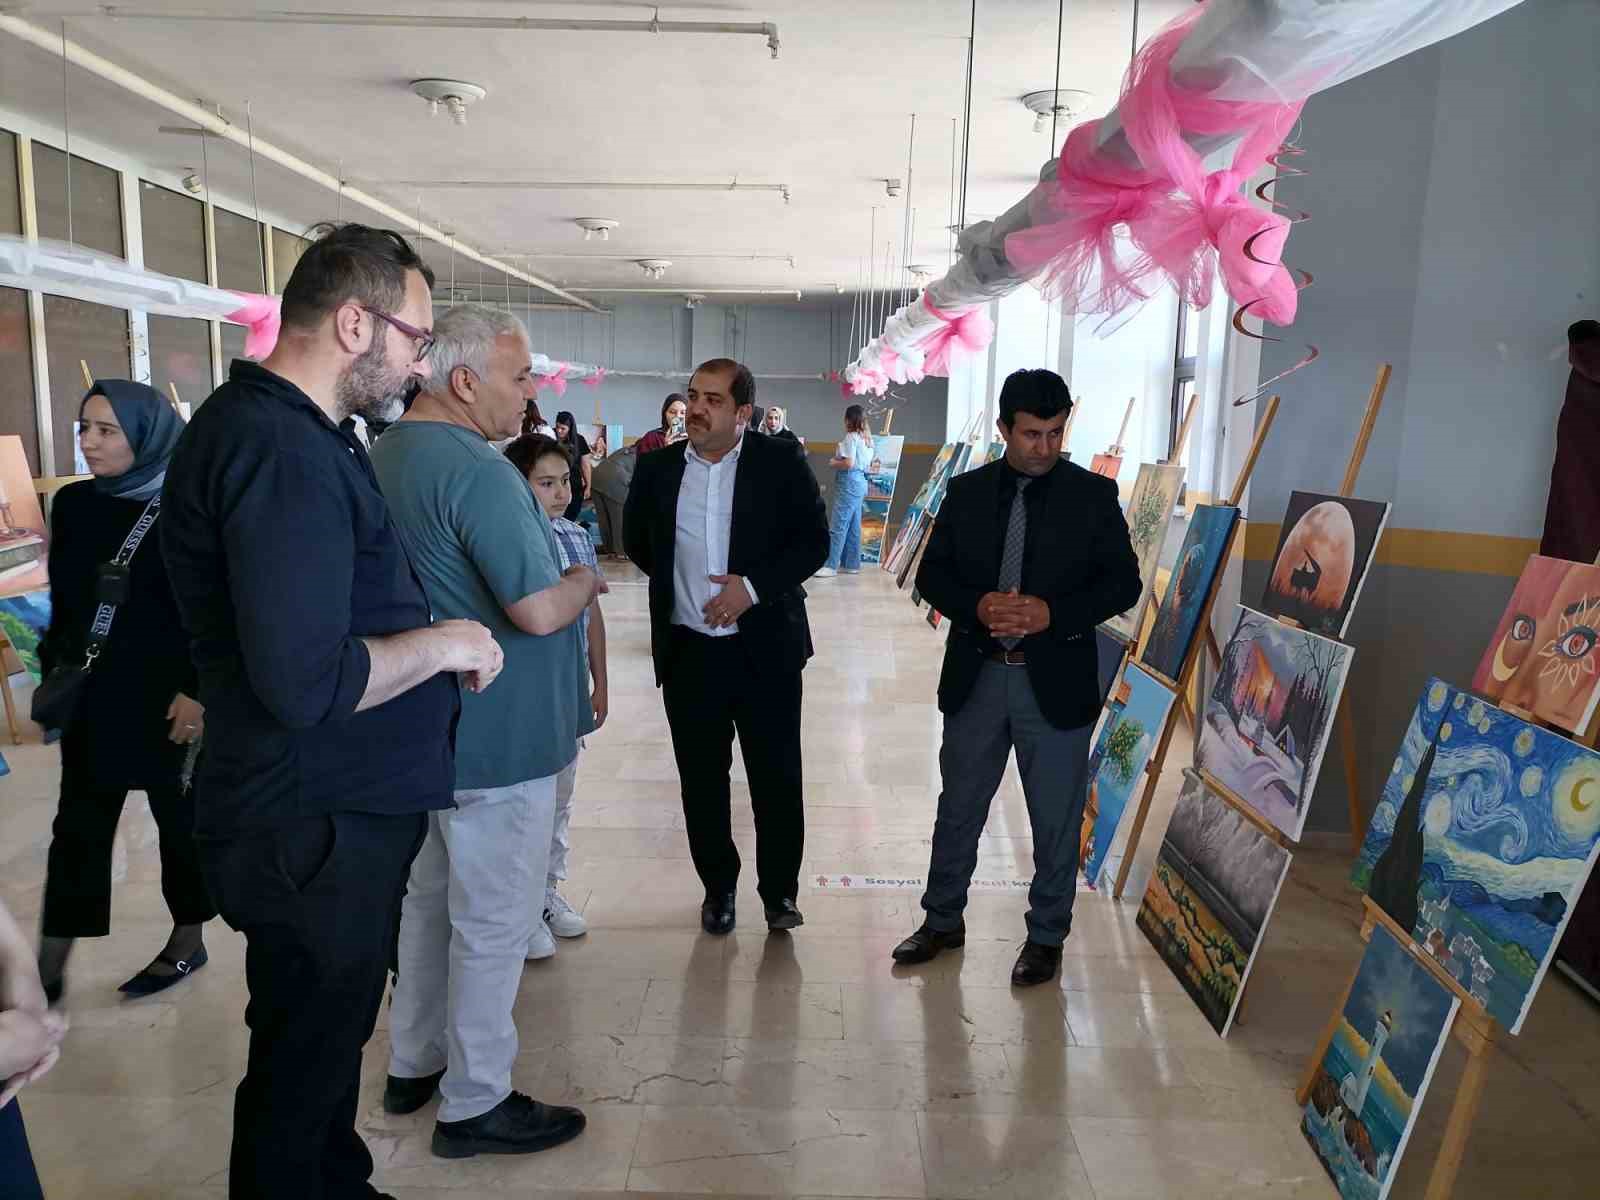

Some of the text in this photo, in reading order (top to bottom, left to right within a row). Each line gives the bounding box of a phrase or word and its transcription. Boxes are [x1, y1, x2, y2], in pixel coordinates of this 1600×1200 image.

[126, 514, 153, 550] GUESS
[95, 604, 111, 634] GUES
[864, 878, 921, 888] Sosyal
